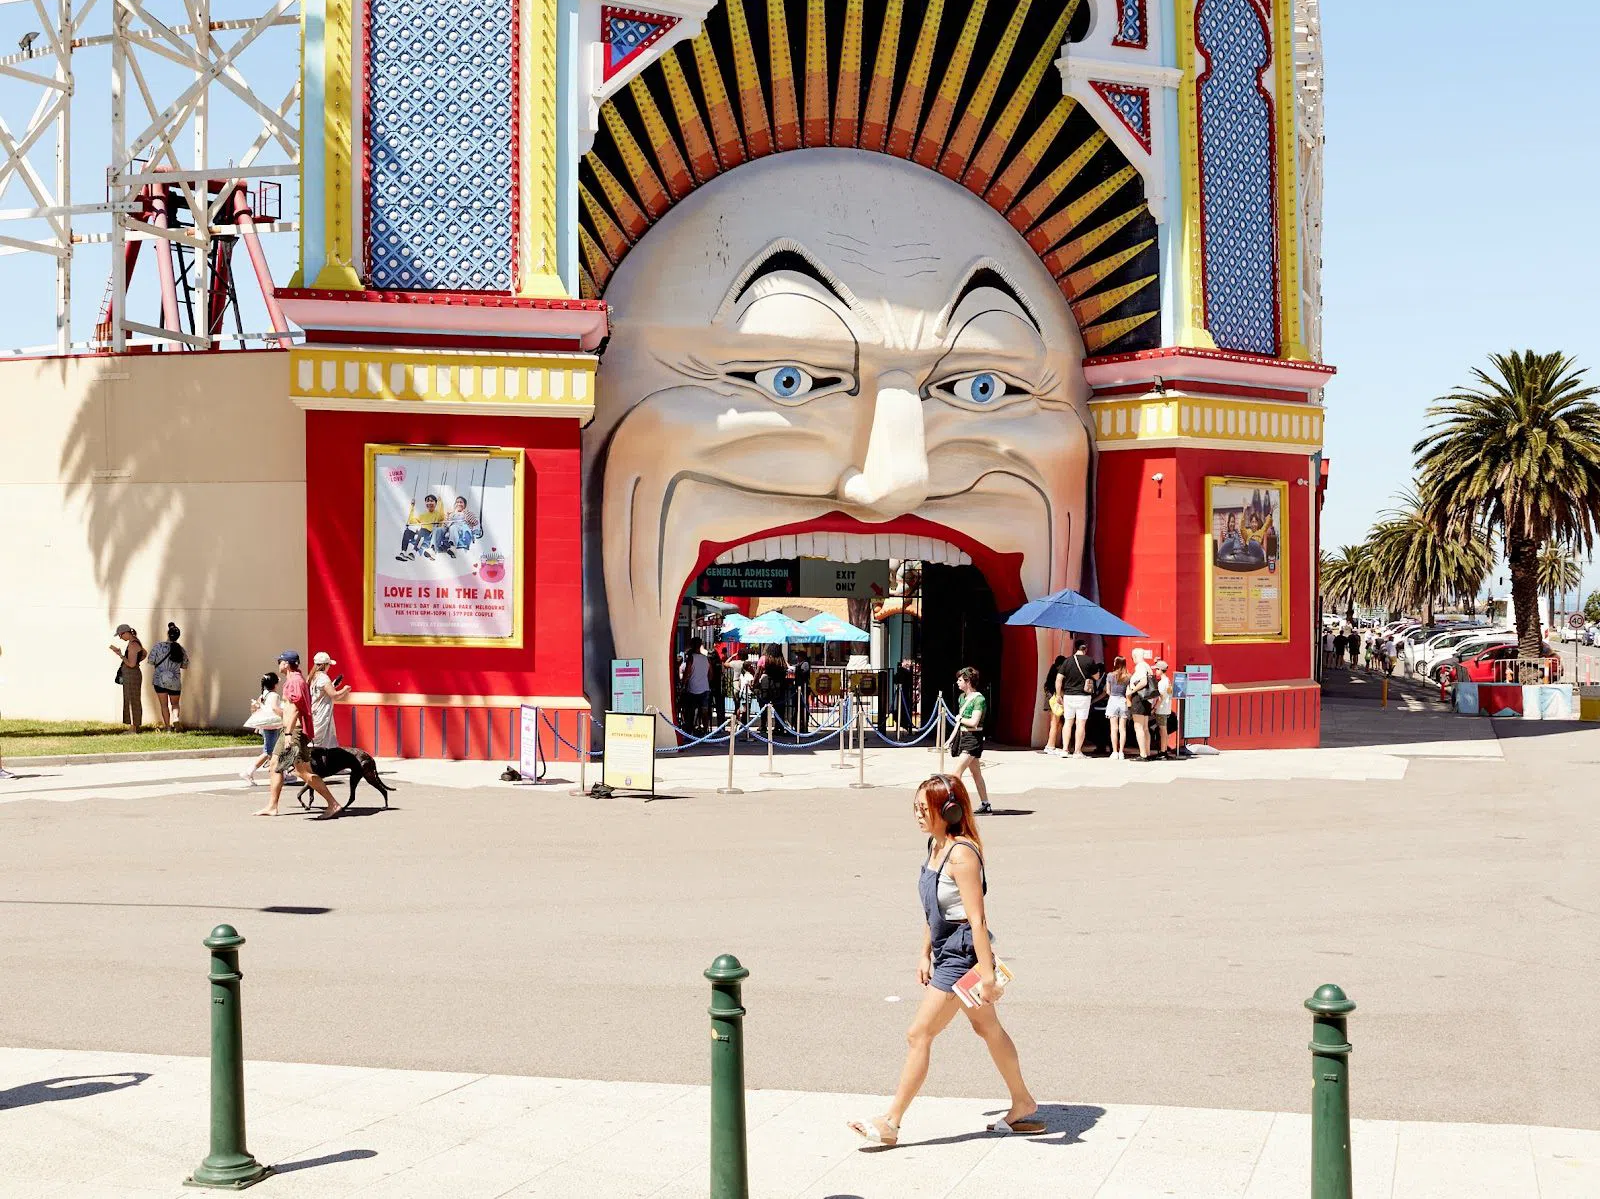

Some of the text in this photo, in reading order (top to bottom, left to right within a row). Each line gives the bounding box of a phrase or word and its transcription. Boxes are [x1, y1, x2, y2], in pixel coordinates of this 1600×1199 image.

[705, 567, 789, 578] GENERAL ADMISSION
[836, 570, 856, 580] EXIT
[722, 579, 773, 589] ALL TICKETS
[835, 582, 856, 592] ONLY
[384, 586, 505, 600] LOVE IS IN THE AIR
[1571, 617, 1582, 625] 40
